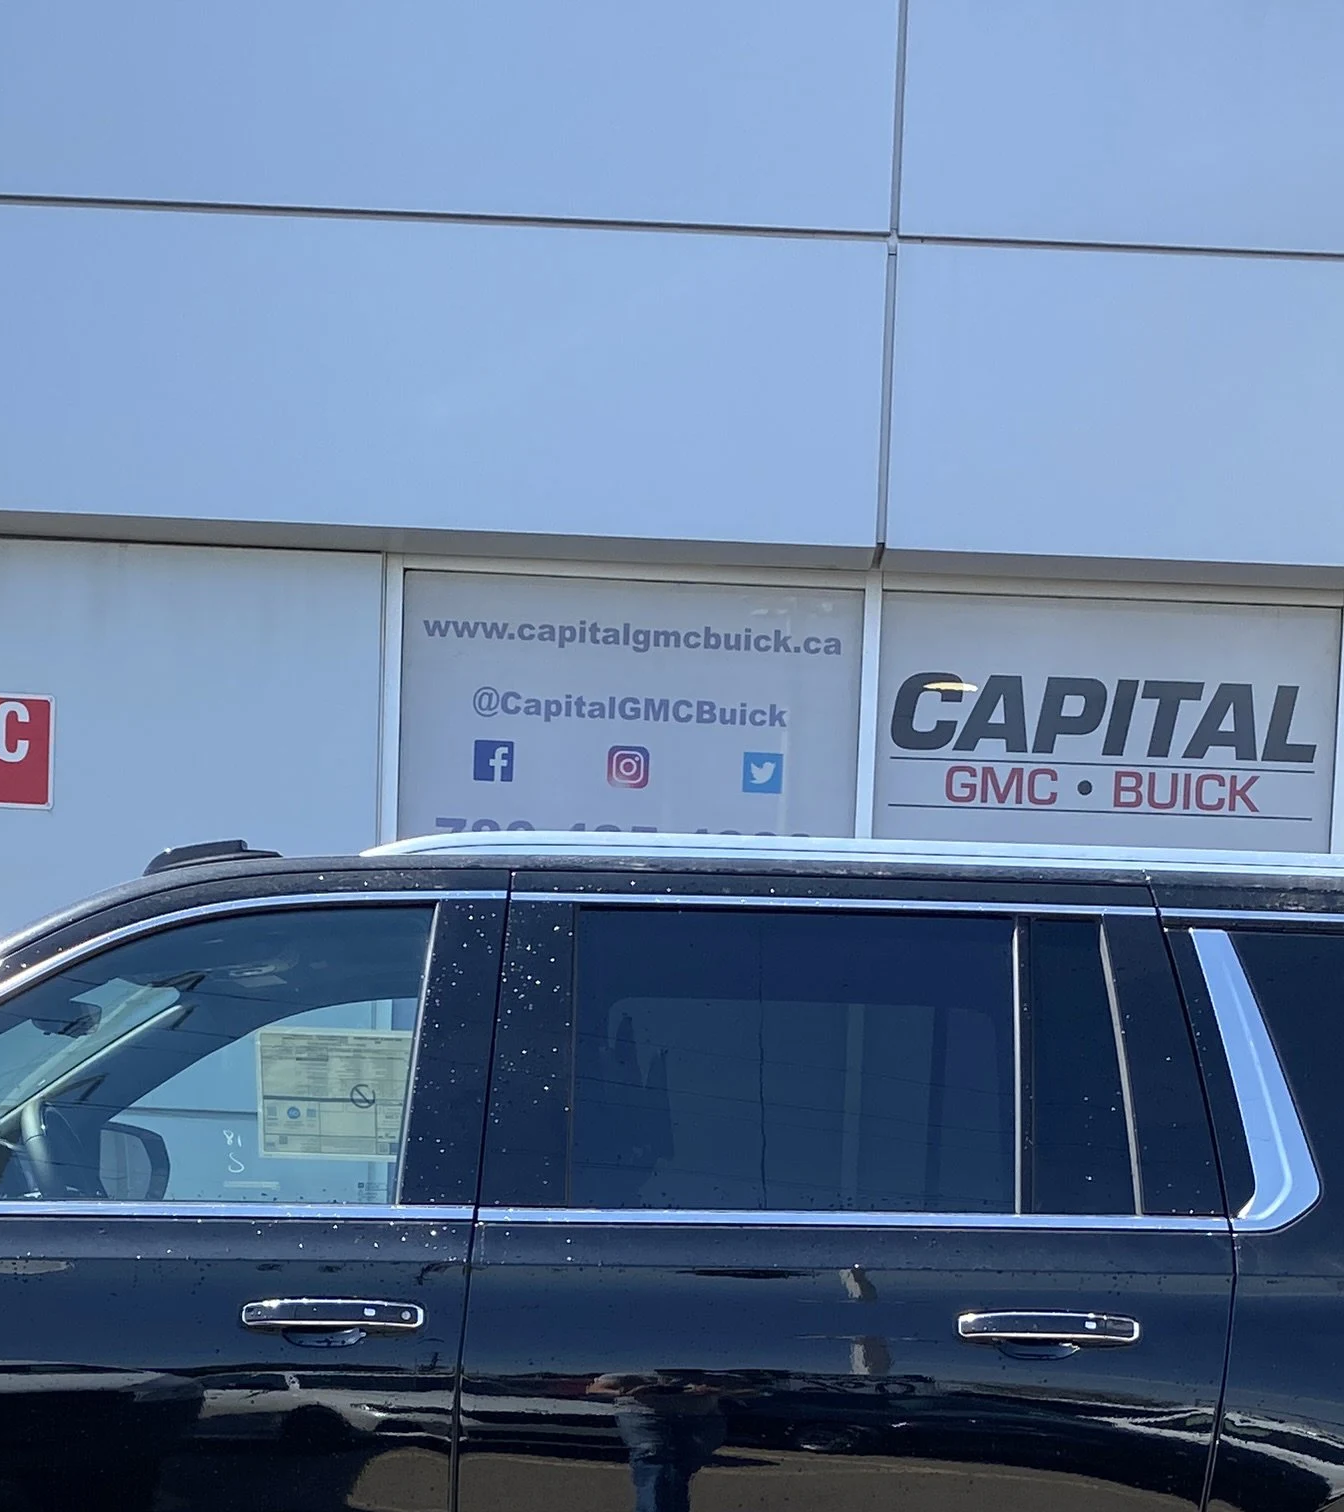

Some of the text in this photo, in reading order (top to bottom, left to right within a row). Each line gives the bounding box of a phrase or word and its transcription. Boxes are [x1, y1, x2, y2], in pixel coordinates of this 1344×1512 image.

[422, 618, 843, 656] www.capitalgmcbuick.ca
[472, 685, 788, 728] @CapitalGMCBuick
[889, 671, 1318, 764] CAPITAL
[944, 765, 1260, 813] GMC BUICK
